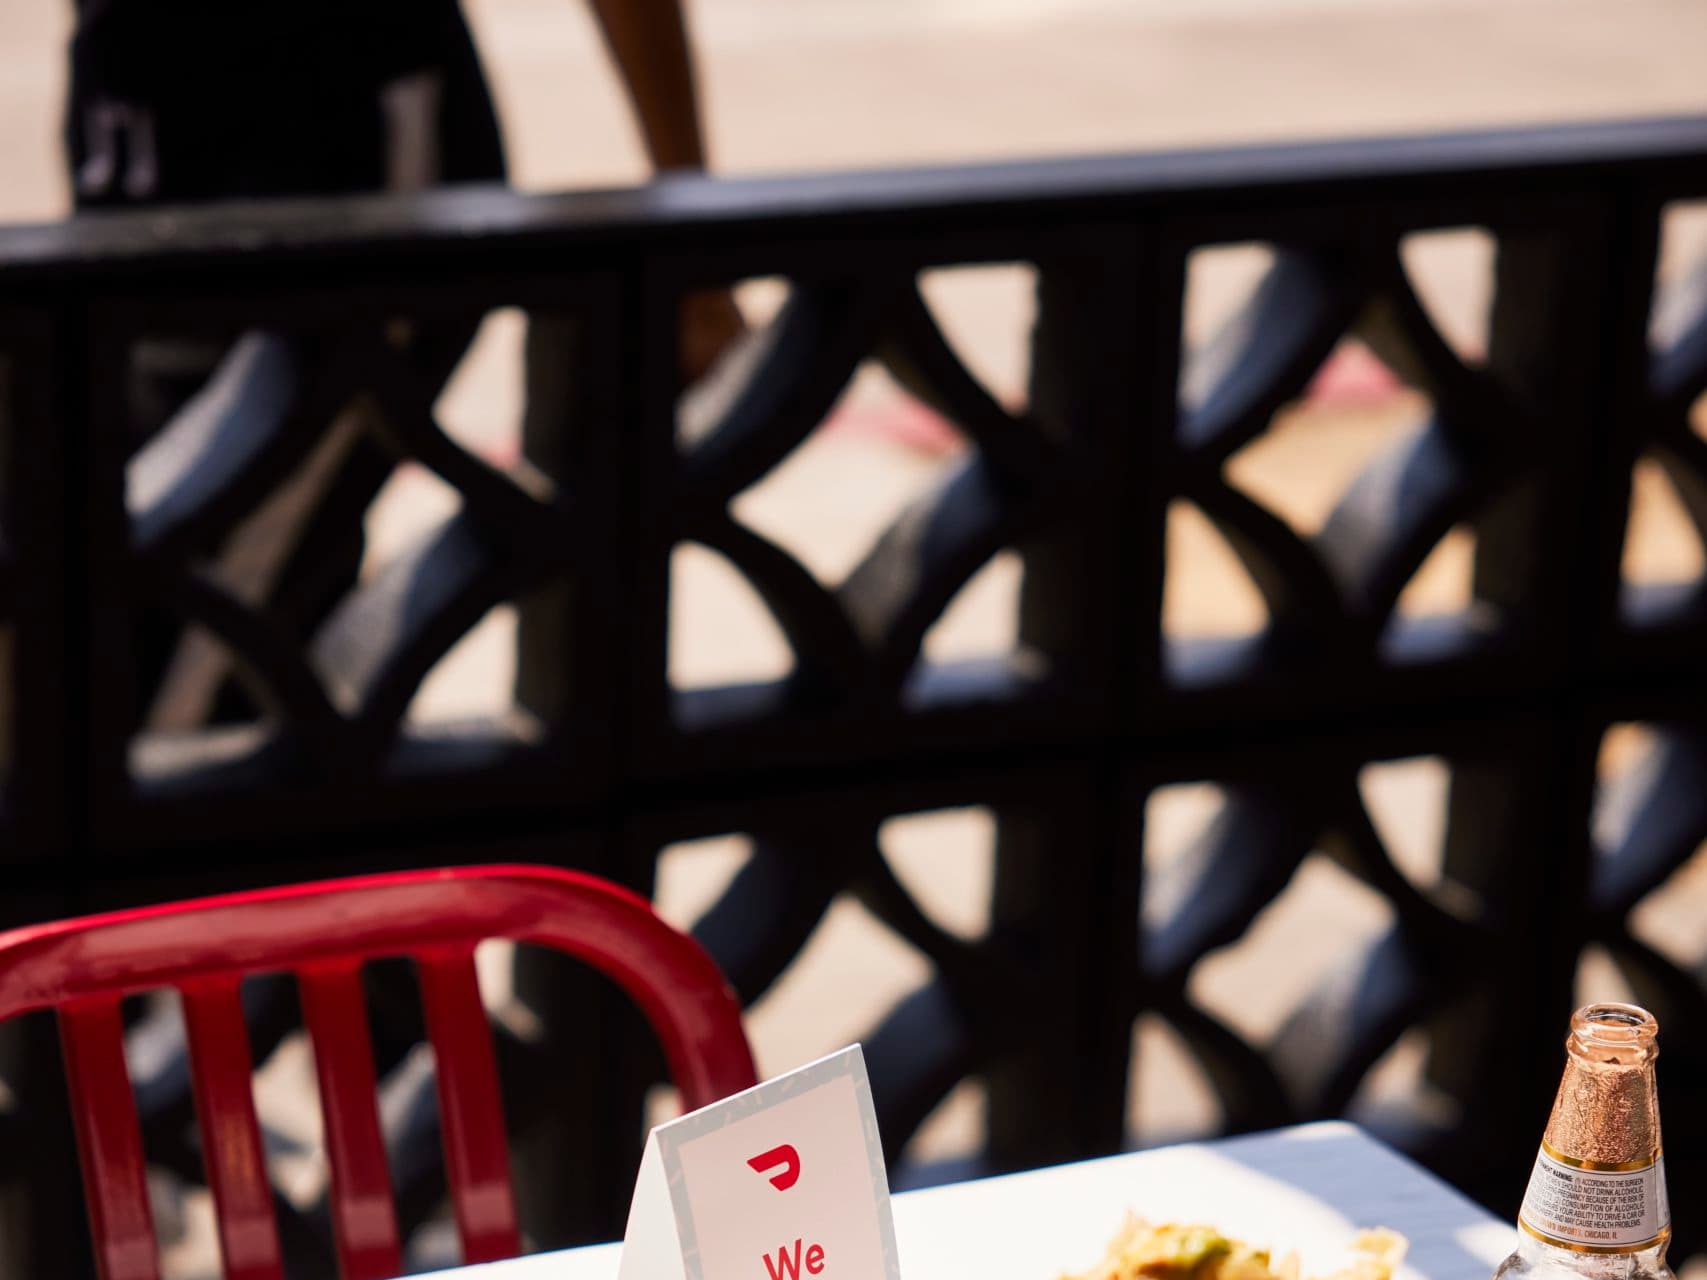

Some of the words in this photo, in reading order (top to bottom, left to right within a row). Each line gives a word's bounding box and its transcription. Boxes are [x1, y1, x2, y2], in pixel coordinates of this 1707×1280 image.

[1561, 1181, 1583, 1193] SHOULD
[1583, 1187, 1595, 1196] NOT
[1596, 1188, 1614, 1196] DRINK
[1614, 1185, 1644, 1196] ALCOHOLIC
[1582, 1178, 1608, 1187] ACCORDING
[1609, 1180, 1615, 1188] TO
[1615, 1179, 1624, 1188] THE
[1624, 1178, 1644, 1187] SURGEON
[1585, 1194, 1609, 1204] BECAUSE
[1610, 1196, 1617, 1204] OF
[1617, 1195, 1627, 1203] THE
[1627, 1194, 1637, 1203] RISK
[1637, 1193, 1645, 1201] OF
[1562, 1198, 1603, 1212] CONSUMPTION
[1605, 1204, 1614, 1213] OF
[1614, 1201, 1645, 1213] ALCOHOLIC
[1559, 1206, 1573, 1217] YOUR
[1574, 1209, 1594, 1220] ABILITY
[1594, 1212, 1604, 1221] TO
[1604, 1212, 1621, 1221] DRIVE
[1621, 1212, 1627, 1220] A
[1627, 1210, 1637, 1220] CAR
[1637, 1209, 1646, 1218] OR
[1575, 1218, 1593, 1228] CAUSE
[1593, 1220, 1615, 1229] HEALTH
